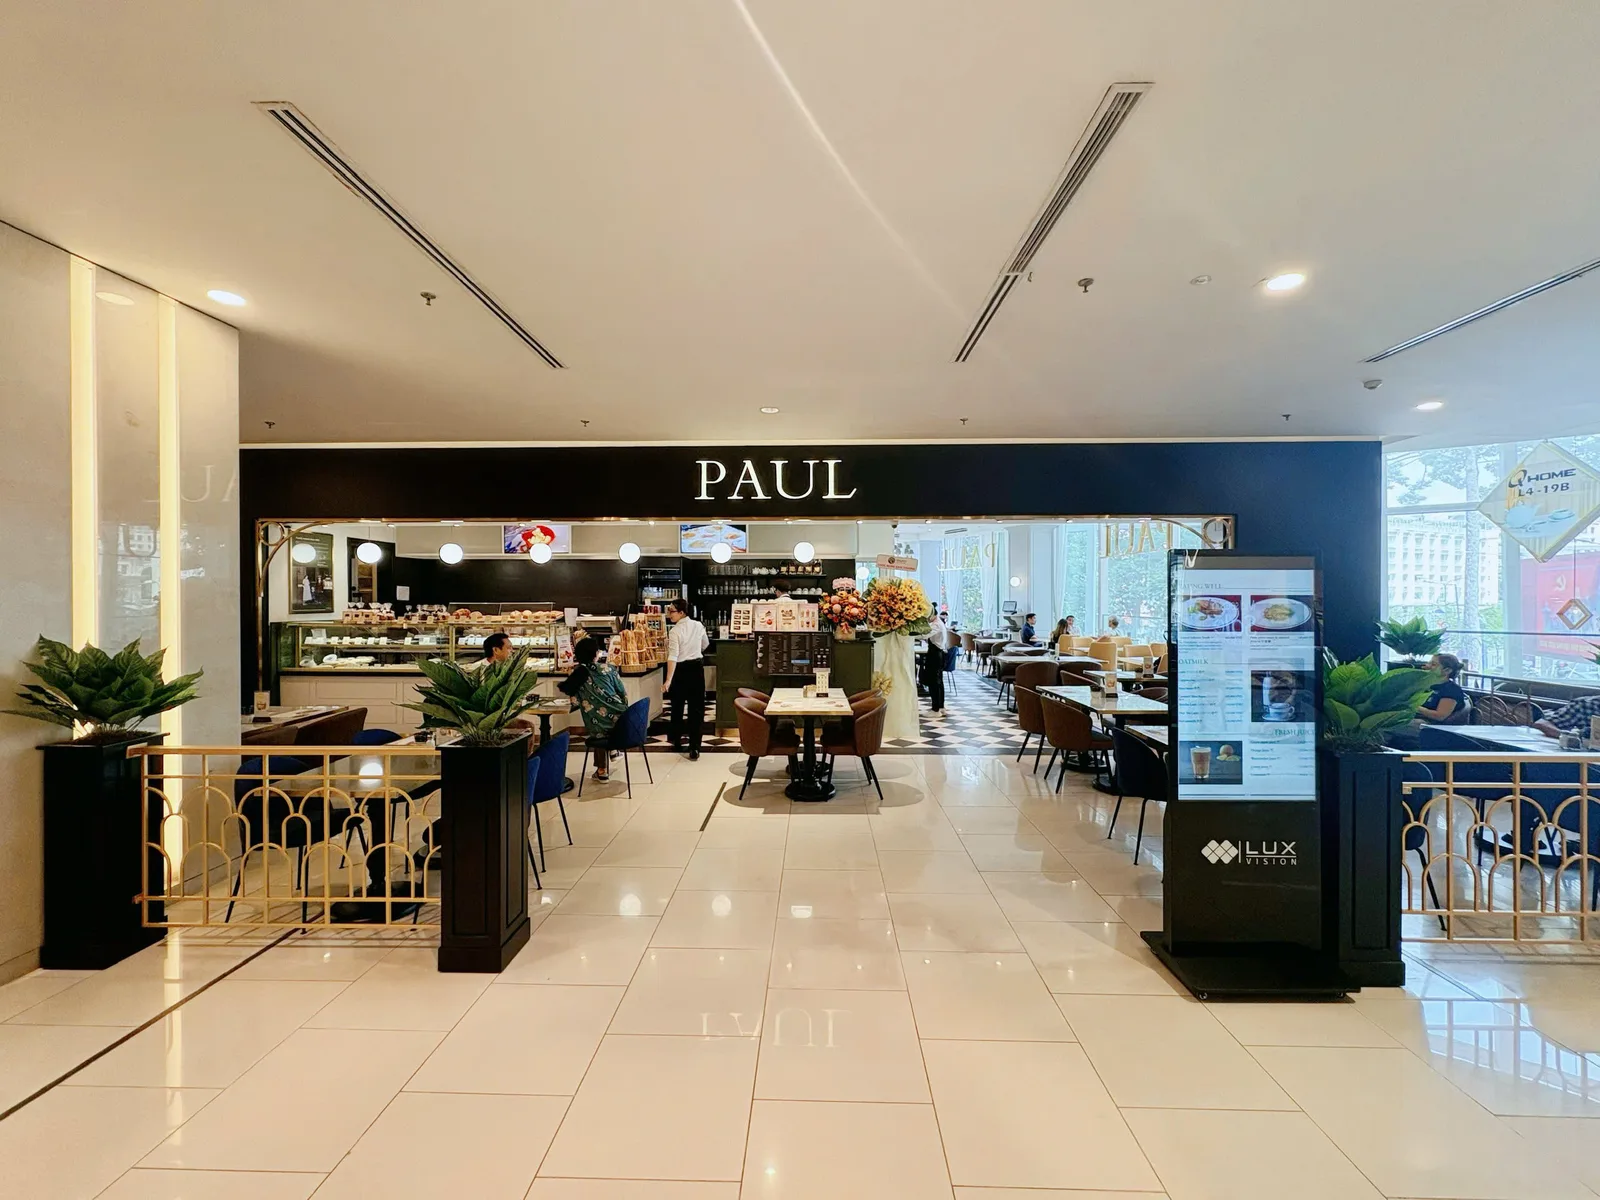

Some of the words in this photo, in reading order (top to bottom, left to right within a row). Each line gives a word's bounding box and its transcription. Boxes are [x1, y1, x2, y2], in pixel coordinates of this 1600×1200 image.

[694, 459, 857, 500] PAUL
[1518, 482, 1570, 497] L4-19B
[1245, 841, 1297, 855] LUX
[1245, 858, 1297, 866] VISION
